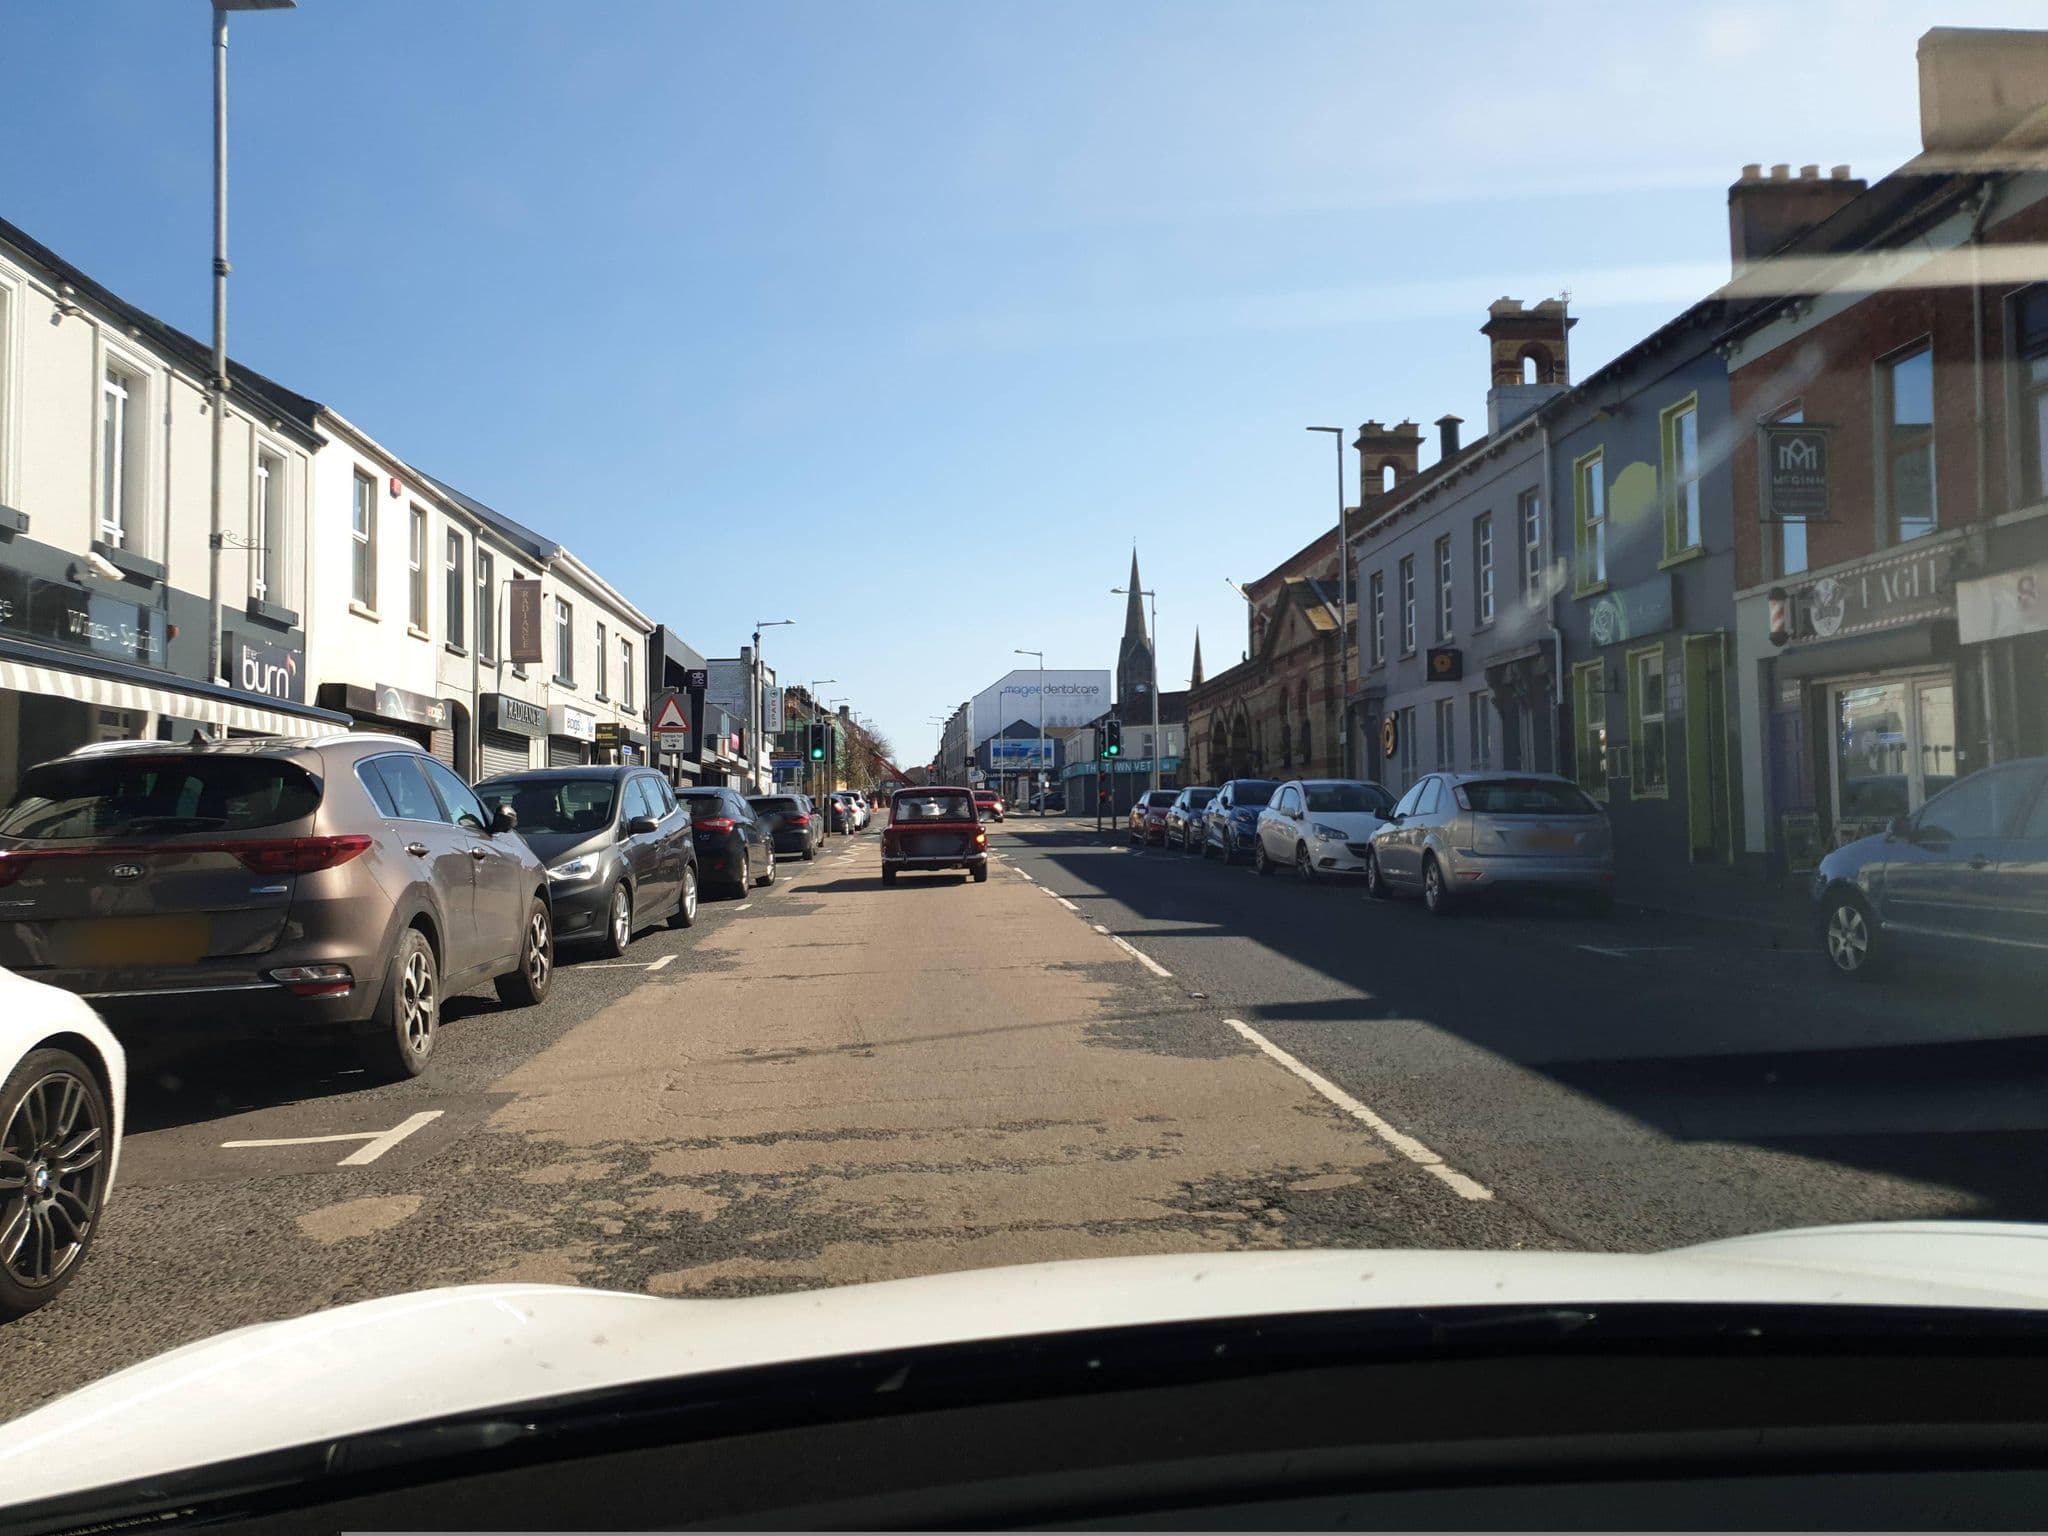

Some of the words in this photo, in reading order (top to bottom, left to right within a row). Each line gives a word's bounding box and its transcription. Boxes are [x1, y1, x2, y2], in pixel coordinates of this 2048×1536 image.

[521, 590, 529, 649] RADIANCE
[242, 645, 289, 699] burn
[506, 699, 542, 727] RADIANCE
[1133, 761, 1151, 772] VET
[113, 867, 138, 876] KIA
